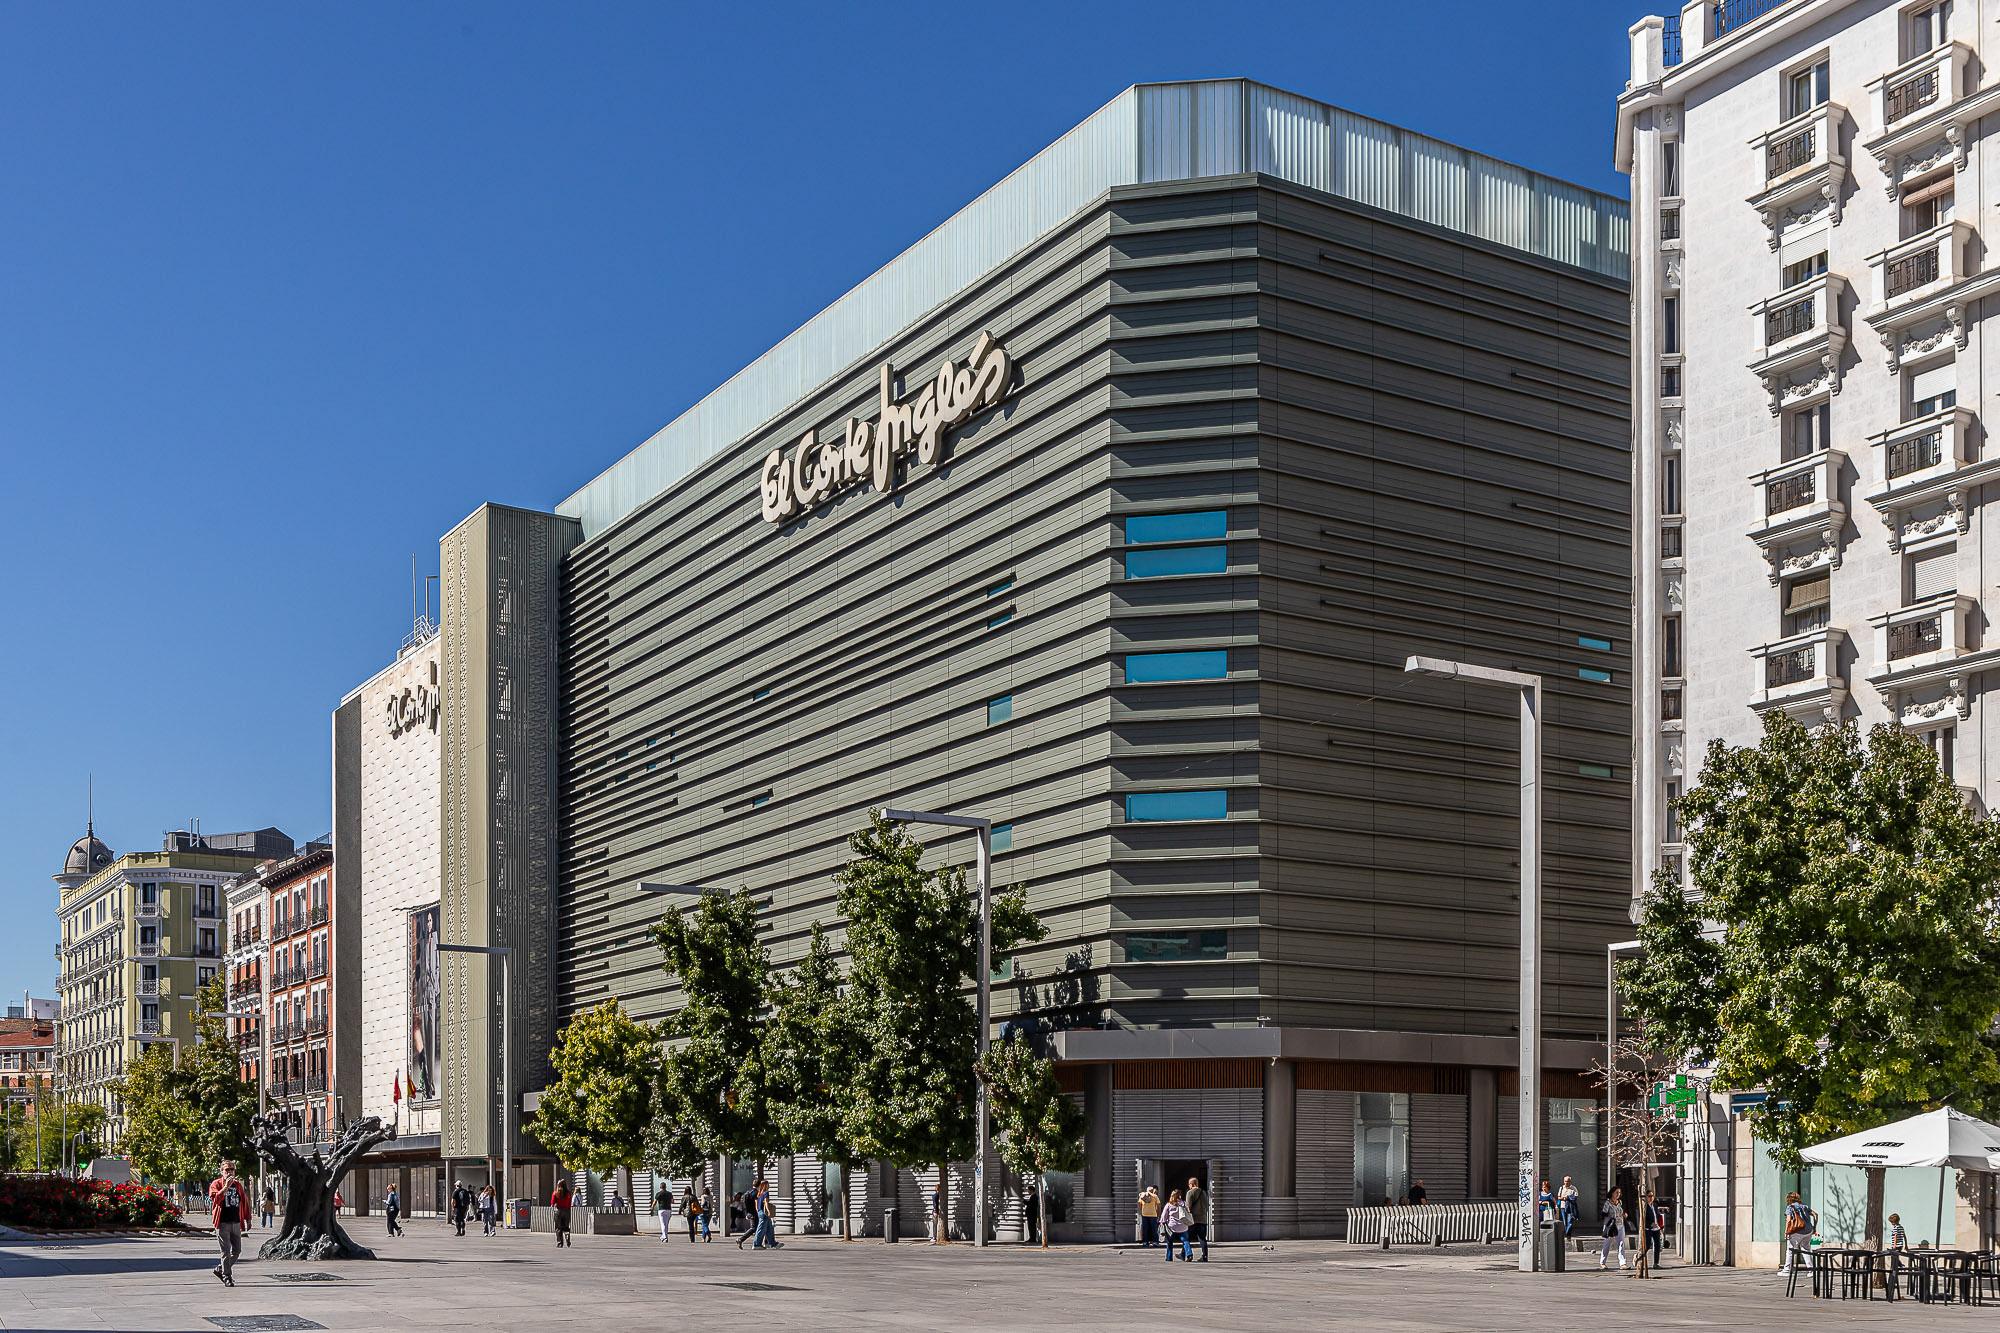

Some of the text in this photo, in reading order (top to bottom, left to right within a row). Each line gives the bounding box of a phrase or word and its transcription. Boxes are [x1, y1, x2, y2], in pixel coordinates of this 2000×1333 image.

[761, 330, 1011, 523] El Corte Inglés
